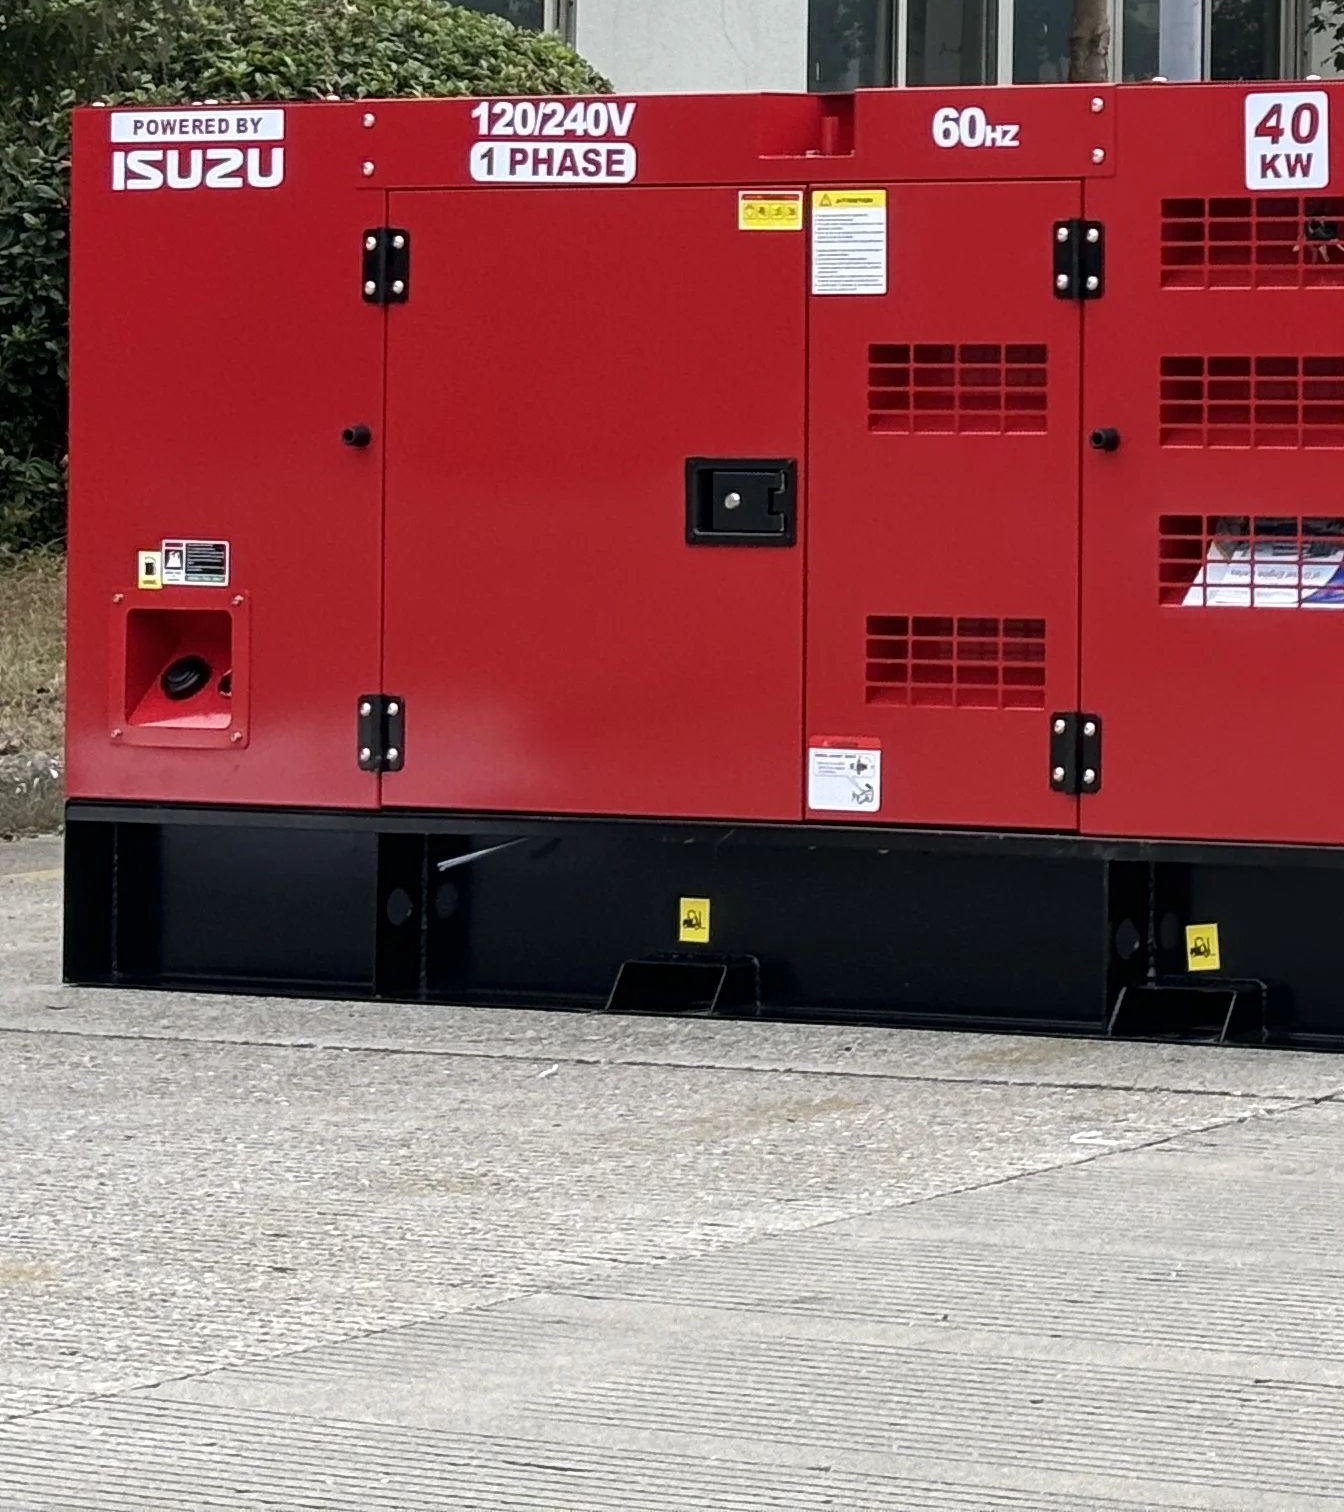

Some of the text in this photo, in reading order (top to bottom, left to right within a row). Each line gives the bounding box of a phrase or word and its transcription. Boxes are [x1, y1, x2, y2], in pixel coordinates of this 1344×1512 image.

[133, 117, 263, 136] POWERED BY
[471, 101, 637, 137] 120/240V
[932, 106, 1020, 148] 60HZ
[1254, 102, 1320, 145] 40
[112, 147, 285, 191] ISUZU
[480, 146, 626, 177] 1 PHASE
[1260, 152, 1314, 180] KW
